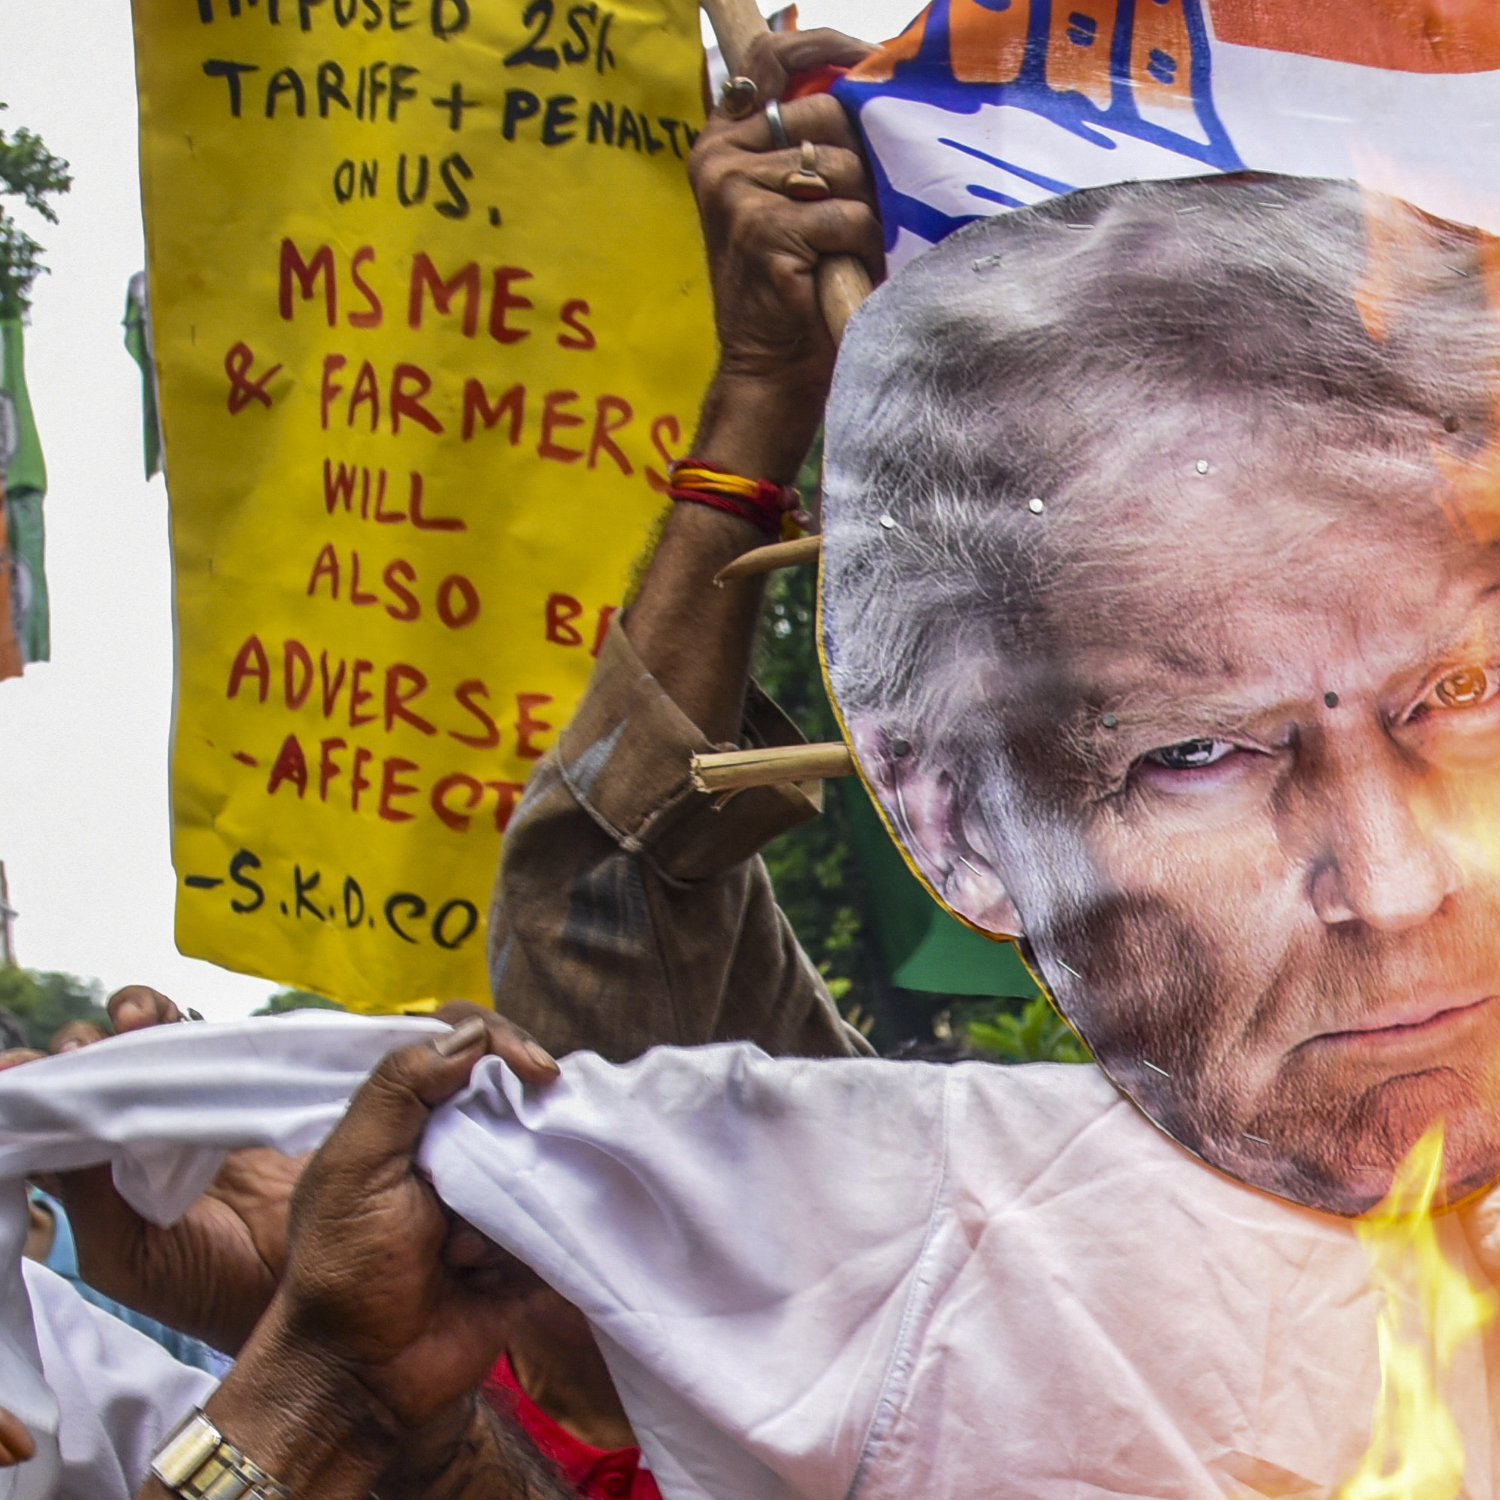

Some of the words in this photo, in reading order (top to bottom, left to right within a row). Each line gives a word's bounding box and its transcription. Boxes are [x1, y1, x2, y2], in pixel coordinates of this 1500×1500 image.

[202, 59, 419, 122] TARIFF
[431, 82, 483, 131] +
[333, 157, 379, 204] ON
[224, 341, 282, 416] &
[320, 353, 690, 494] FARMERS
[323, 457, 467, 532] WILL
[306, 543, 481, 630] ALSO
